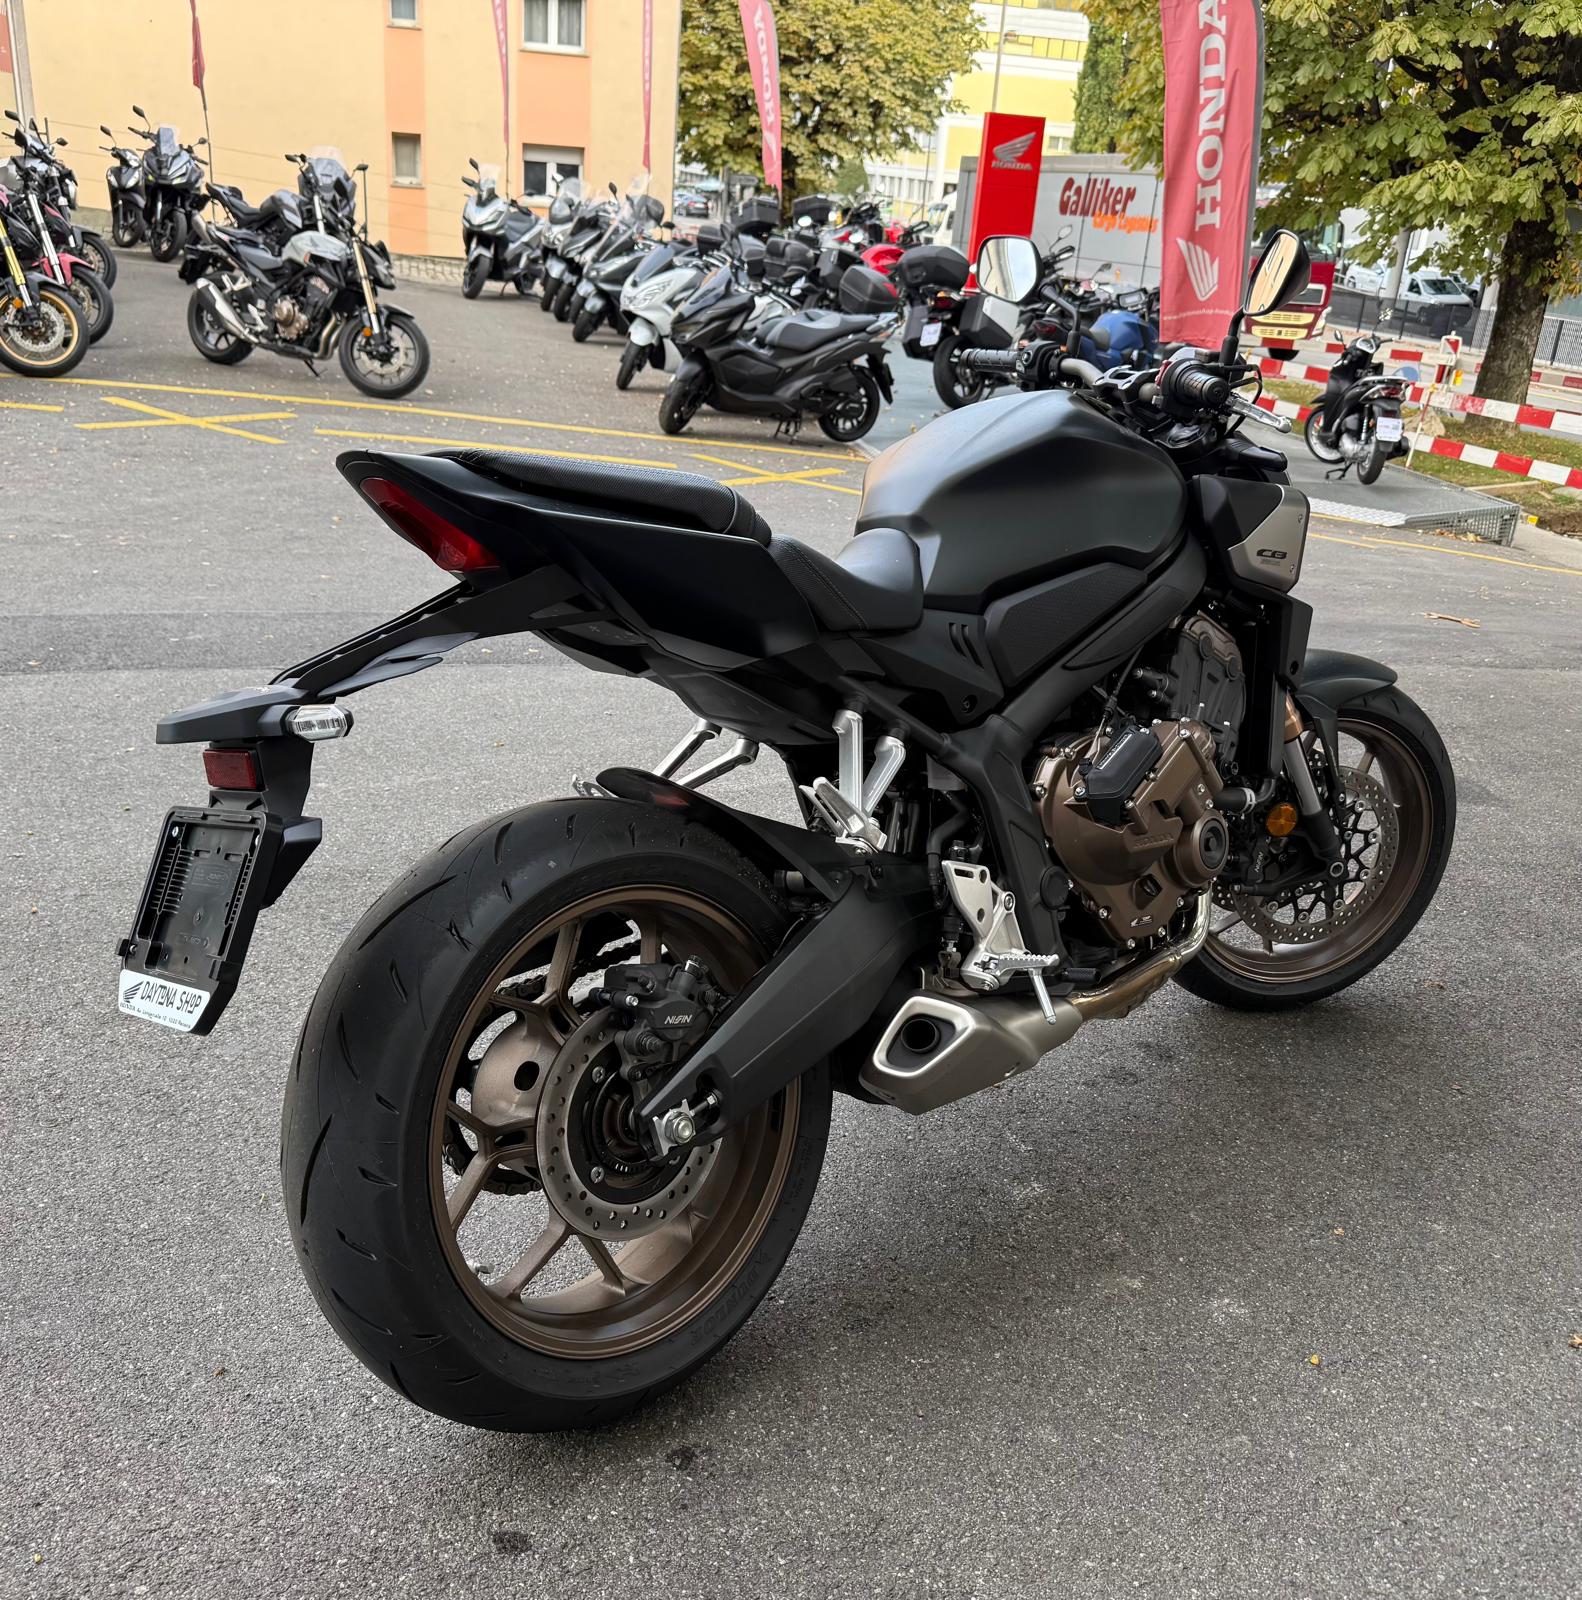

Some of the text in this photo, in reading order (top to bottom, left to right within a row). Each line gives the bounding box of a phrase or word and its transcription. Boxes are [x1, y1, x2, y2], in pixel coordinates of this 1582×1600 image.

[1195, 0, 1227, 231] HONDA
[1059, 177, 1137, 217] Galliker
[140, 981, 203, 1014] DAYTONA SHOP
